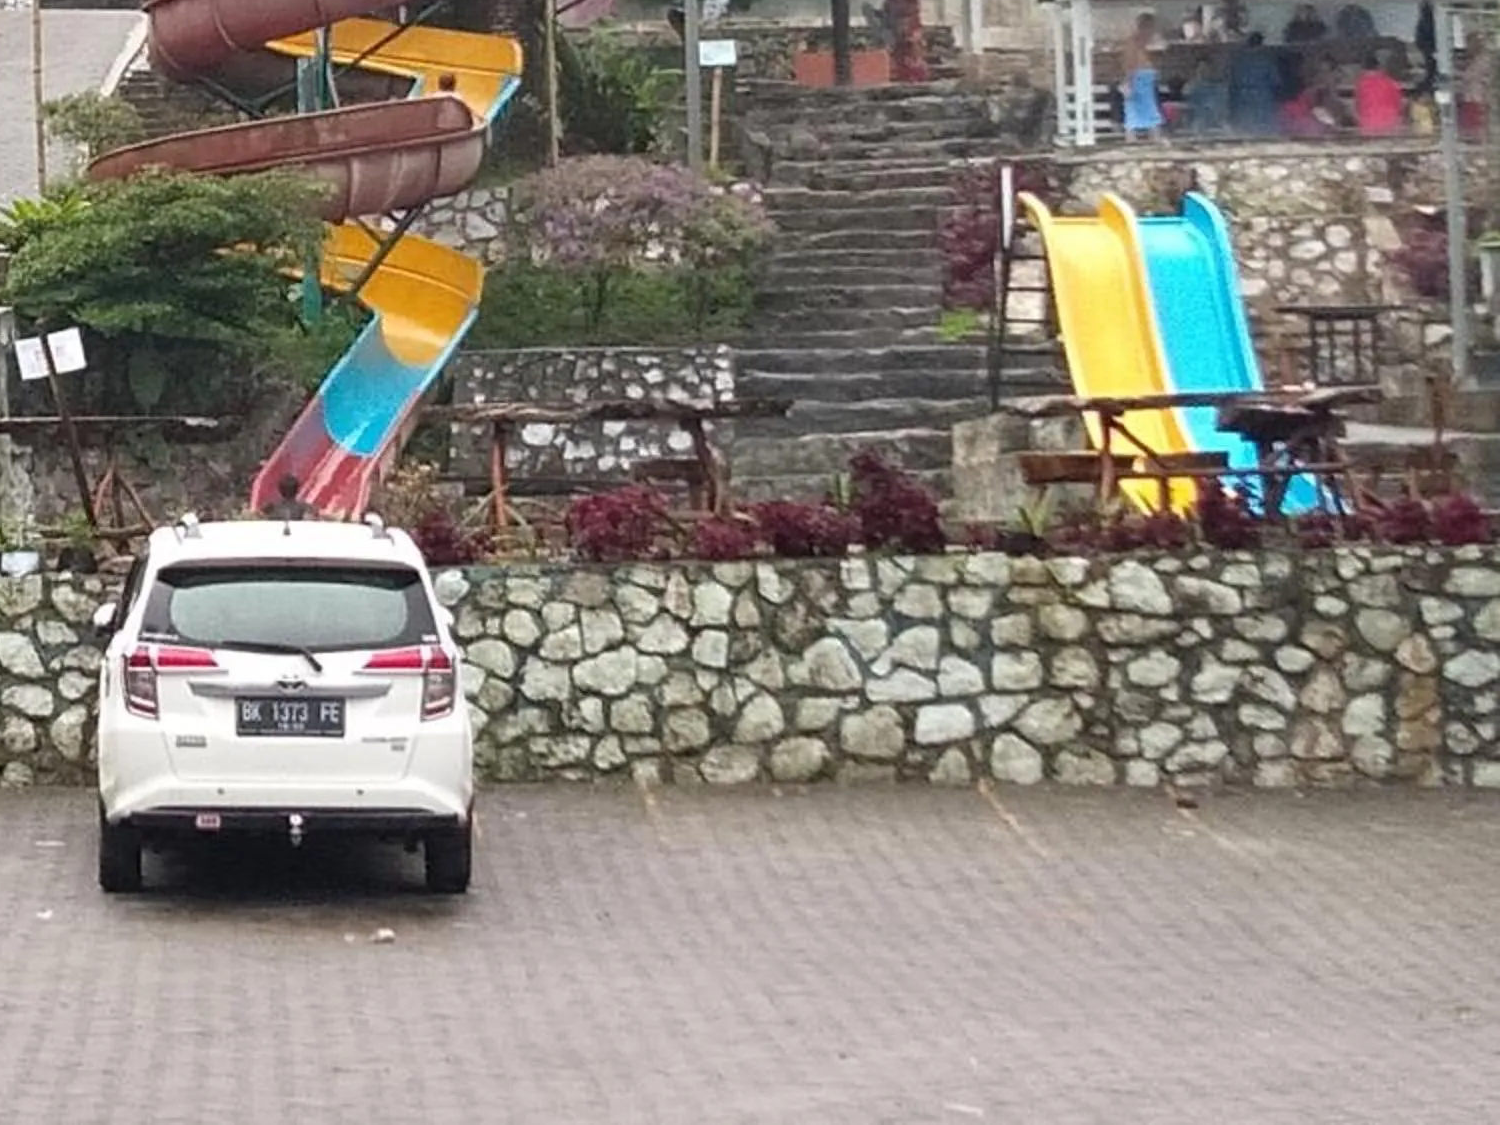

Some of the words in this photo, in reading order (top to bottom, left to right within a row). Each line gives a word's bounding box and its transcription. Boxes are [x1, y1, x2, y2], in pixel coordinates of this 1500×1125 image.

[242, 701, 262, 722] BK
[273, 702, 309, 722] 1373
[321, 702, 340, 723] FE
